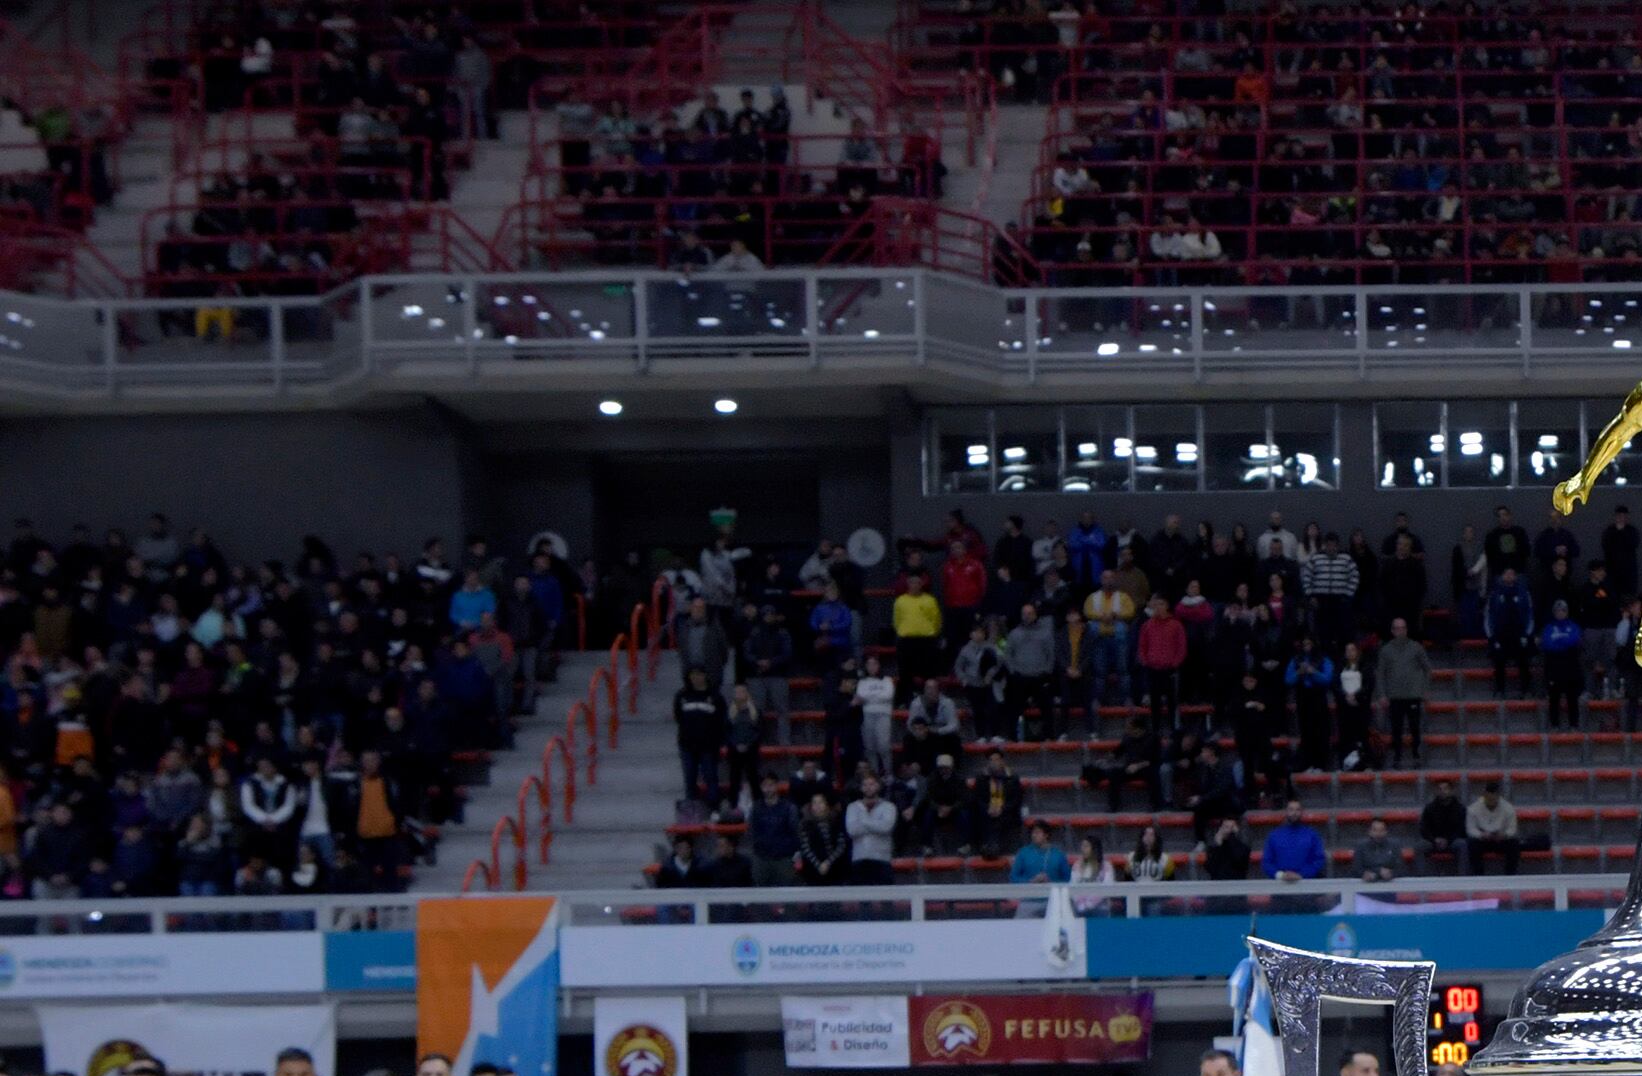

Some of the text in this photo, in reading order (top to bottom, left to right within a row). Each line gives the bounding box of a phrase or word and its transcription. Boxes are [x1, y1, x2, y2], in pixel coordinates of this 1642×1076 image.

[768, 943, 914, 956] MENDOZA GOBIERNO
[1447, 987, 1479, 1013] 00
[821, 1022, 893, 1034] Publicidad
[1004, 1019, 1104, 1039] FEFUSA
[1464, 1021, 1480, 1042] 0
[843, 1038, 889, 1051] Diseño
